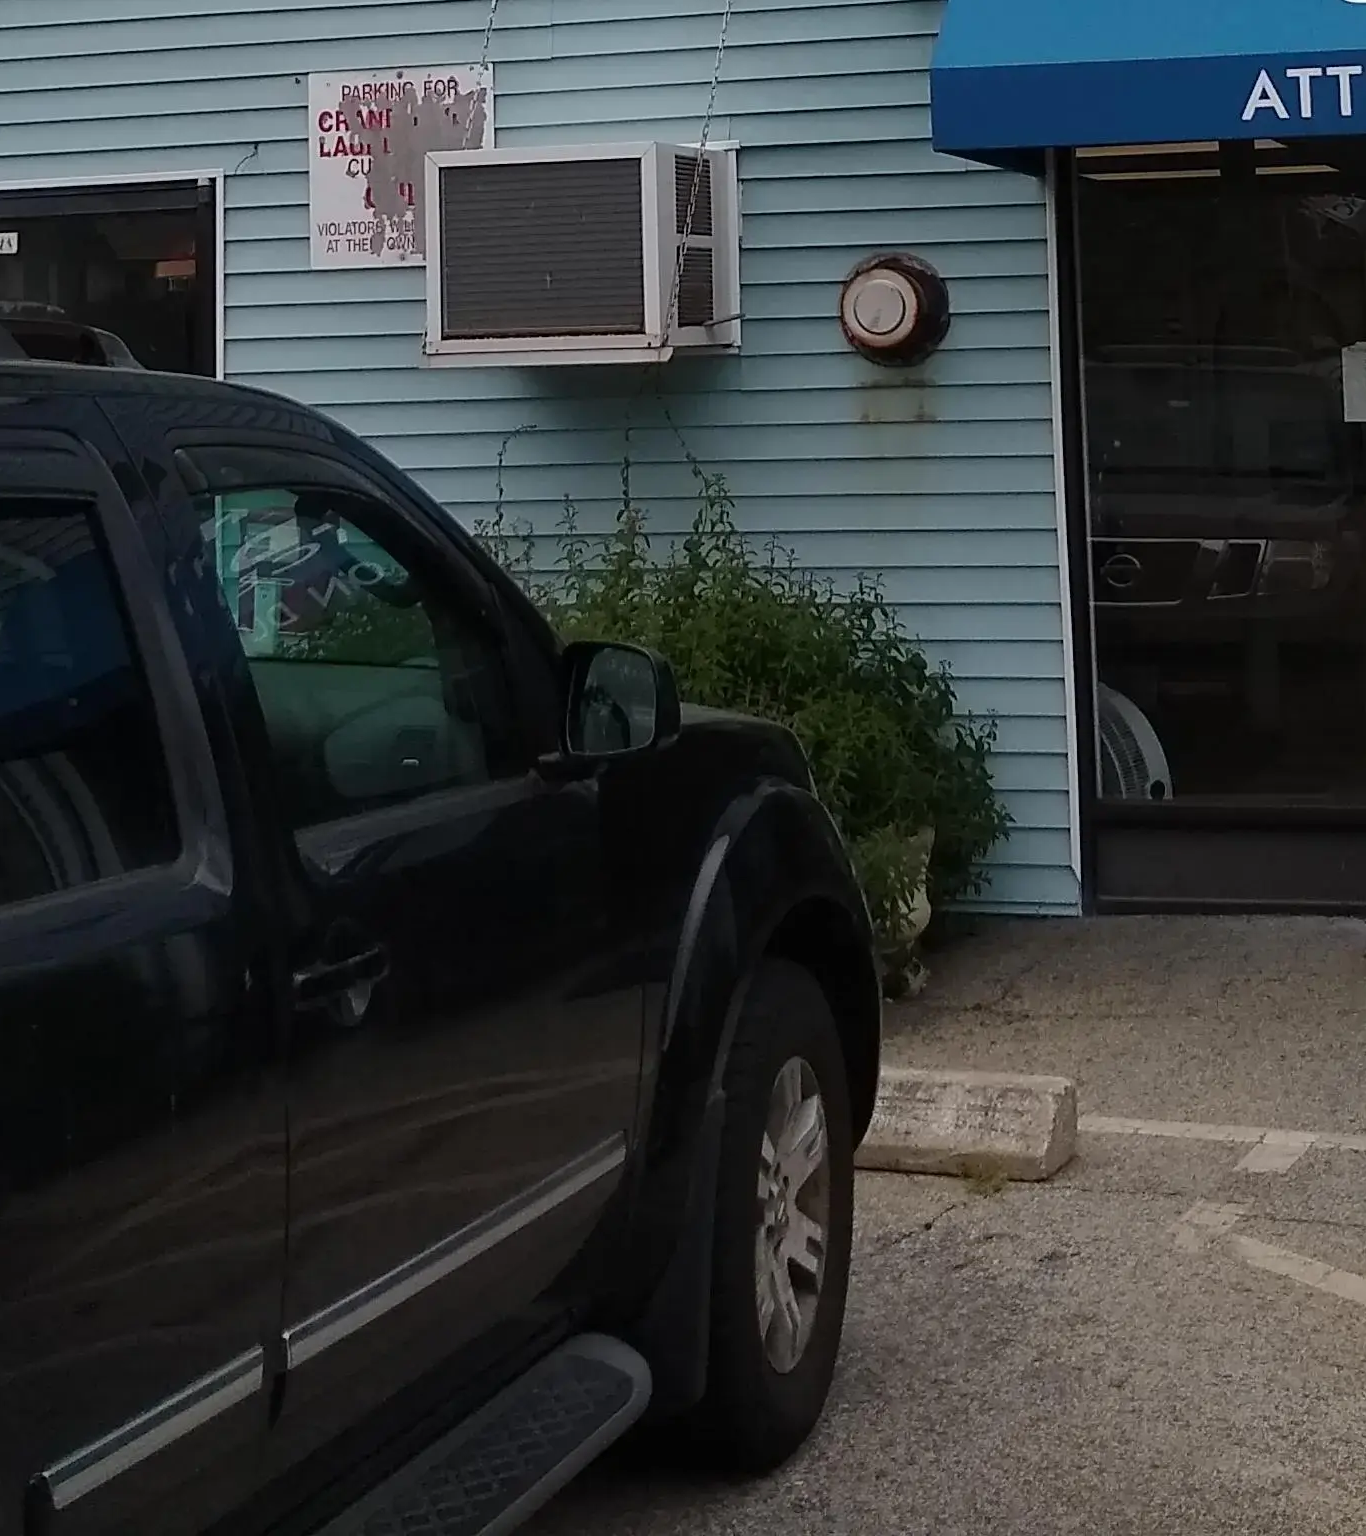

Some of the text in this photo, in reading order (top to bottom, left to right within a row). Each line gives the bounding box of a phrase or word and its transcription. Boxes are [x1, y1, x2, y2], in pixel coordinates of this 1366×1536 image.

[424, 78, 459, 98] FOR
[326, 239, 340, 253] AT
[386, 234, 415, 250] OWN
